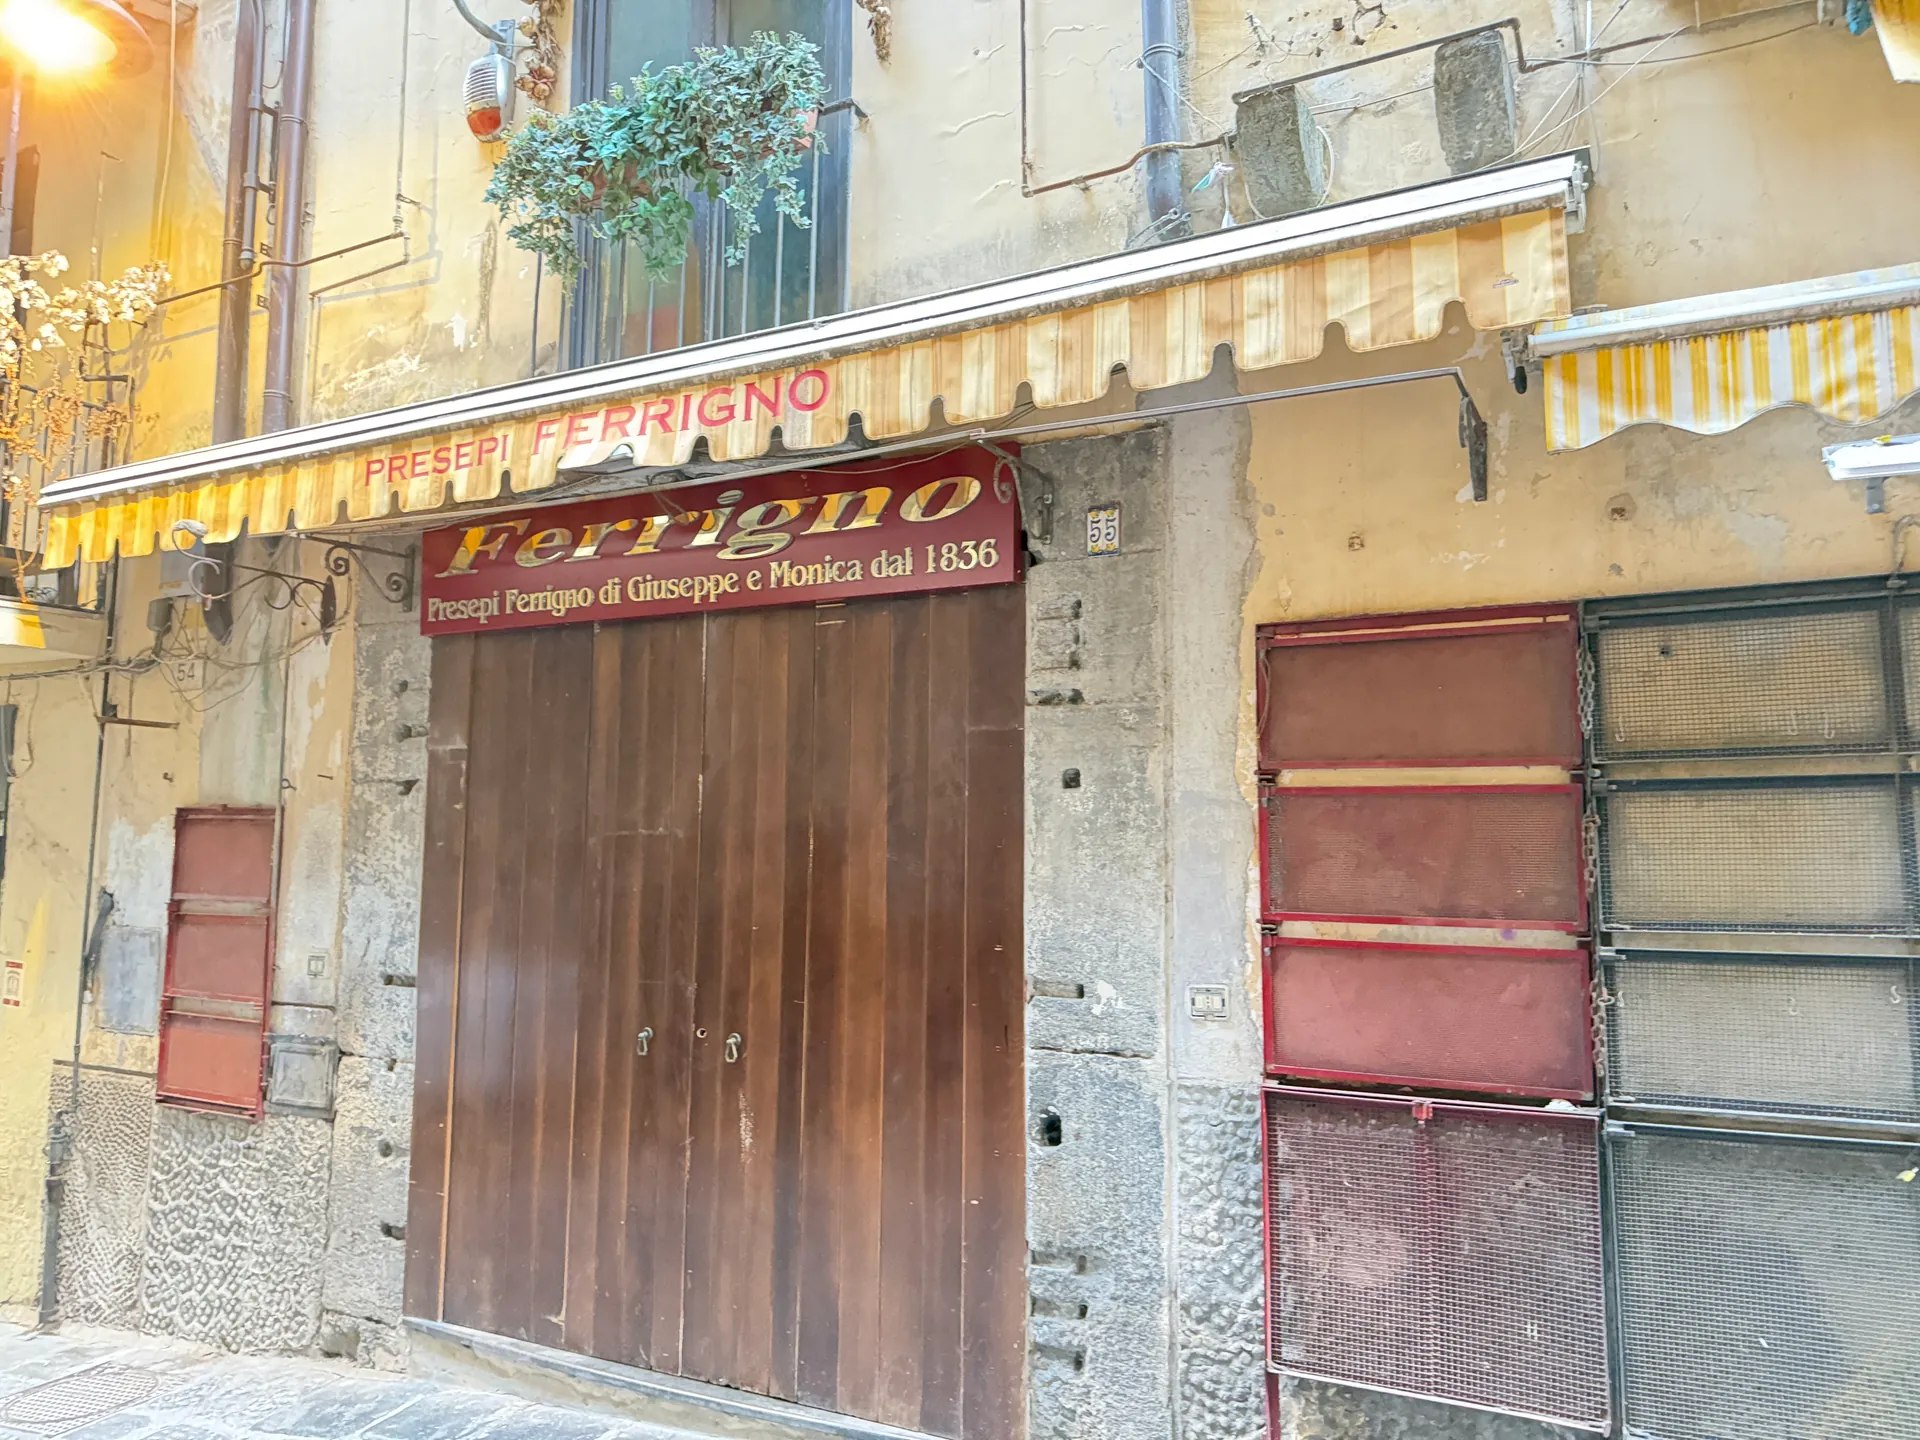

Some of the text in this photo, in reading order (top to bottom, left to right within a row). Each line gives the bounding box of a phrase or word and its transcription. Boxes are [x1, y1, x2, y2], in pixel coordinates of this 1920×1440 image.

[365, 368, 832, 487] PRESEPI FERRIGNO
[434, 476, 983, 579] Ferrigno
[1090, 517, 1116, 543] 55
[427, 538, 1000, 624] Presepi Ferrigno di Giuseppe e Monica dal 1836
[176, 661, 196, 682] 54
